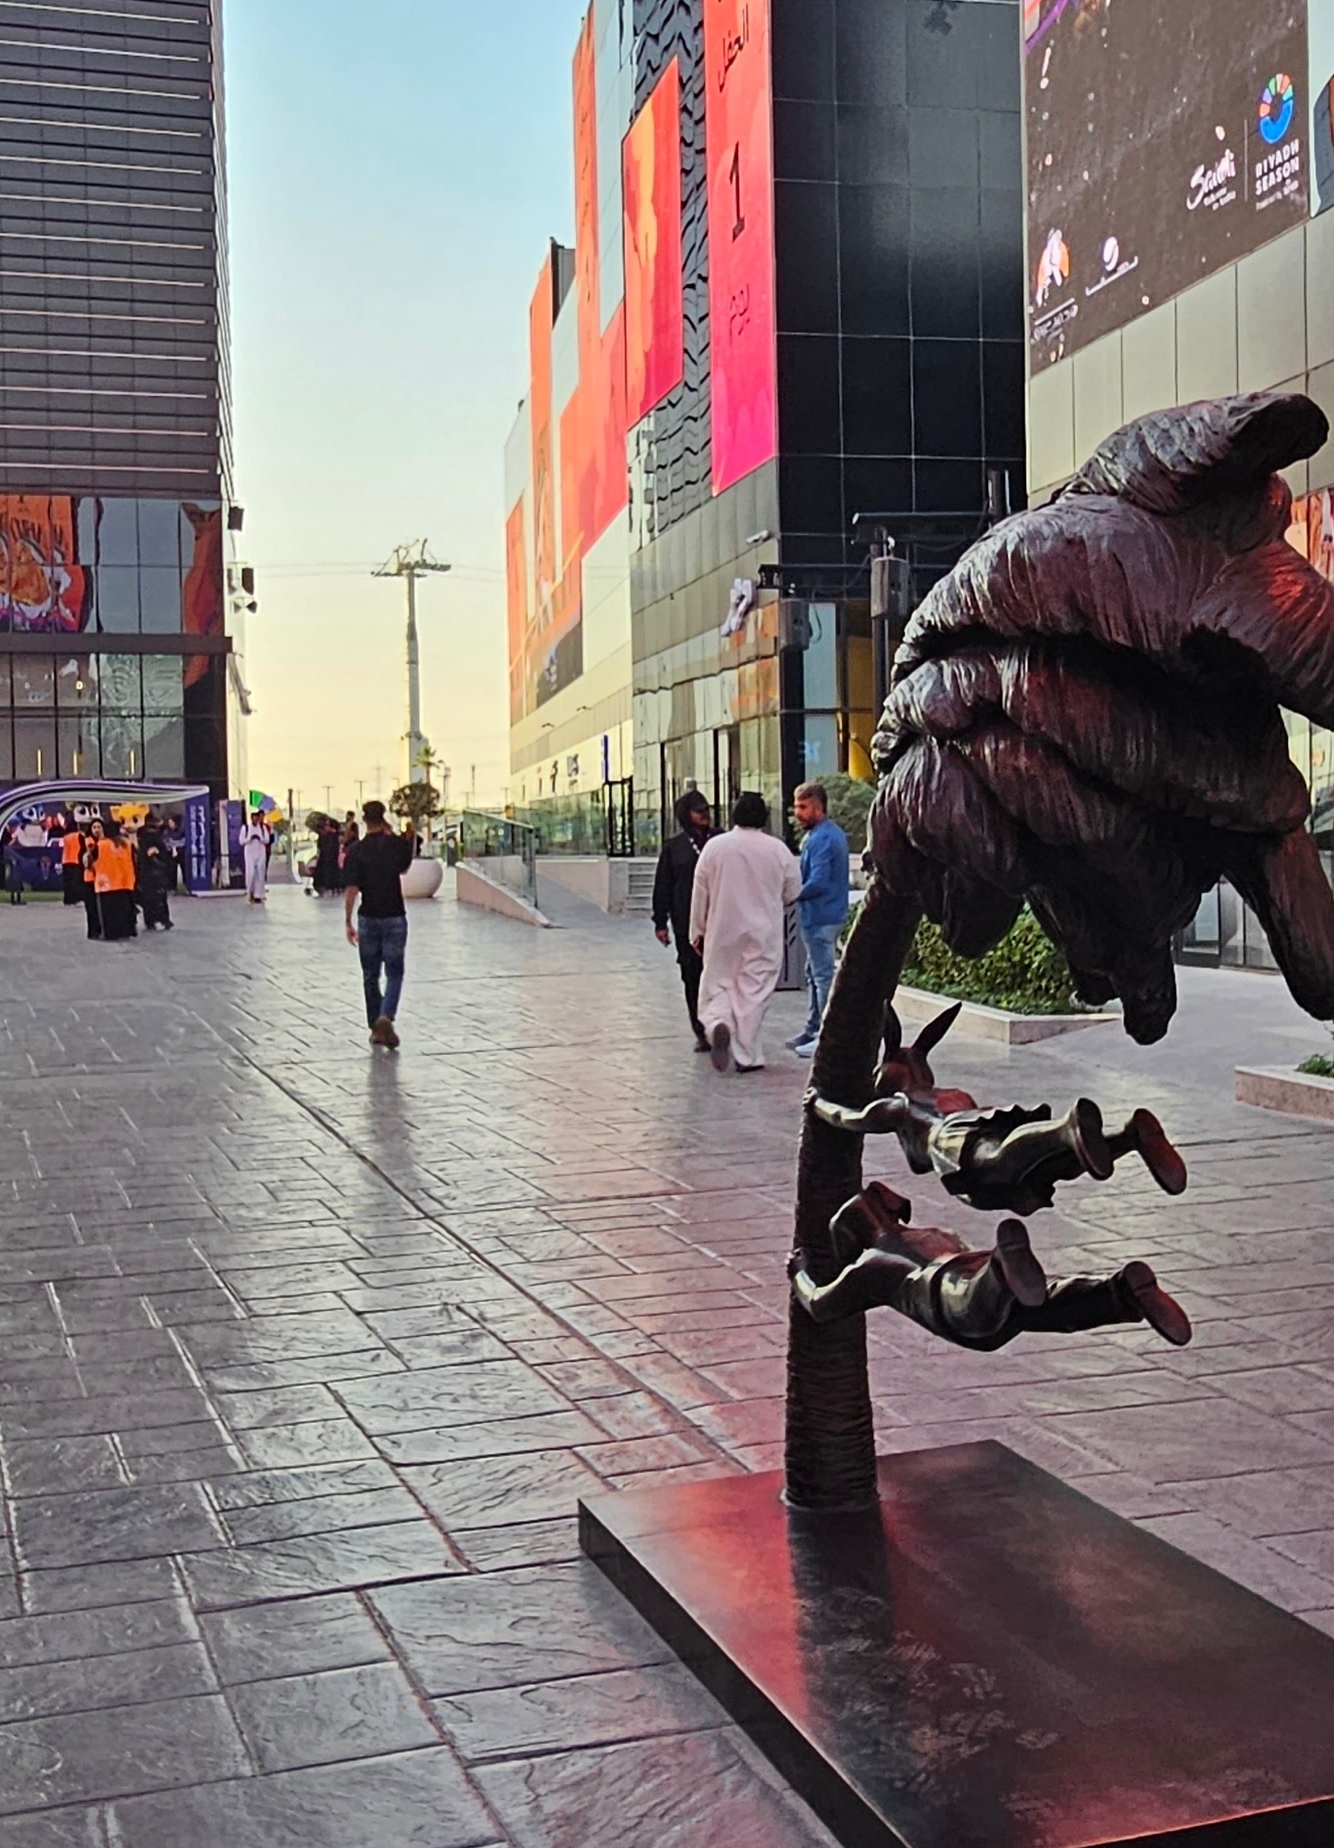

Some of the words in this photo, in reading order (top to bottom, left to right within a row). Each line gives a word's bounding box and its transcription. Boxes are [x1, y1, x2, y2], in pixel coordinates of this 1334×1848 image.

[1255, 138, 1300, 178] RIYADH
[1255, 156, 1300, 196] SEASON
[728, 140, 746, 244] 1
